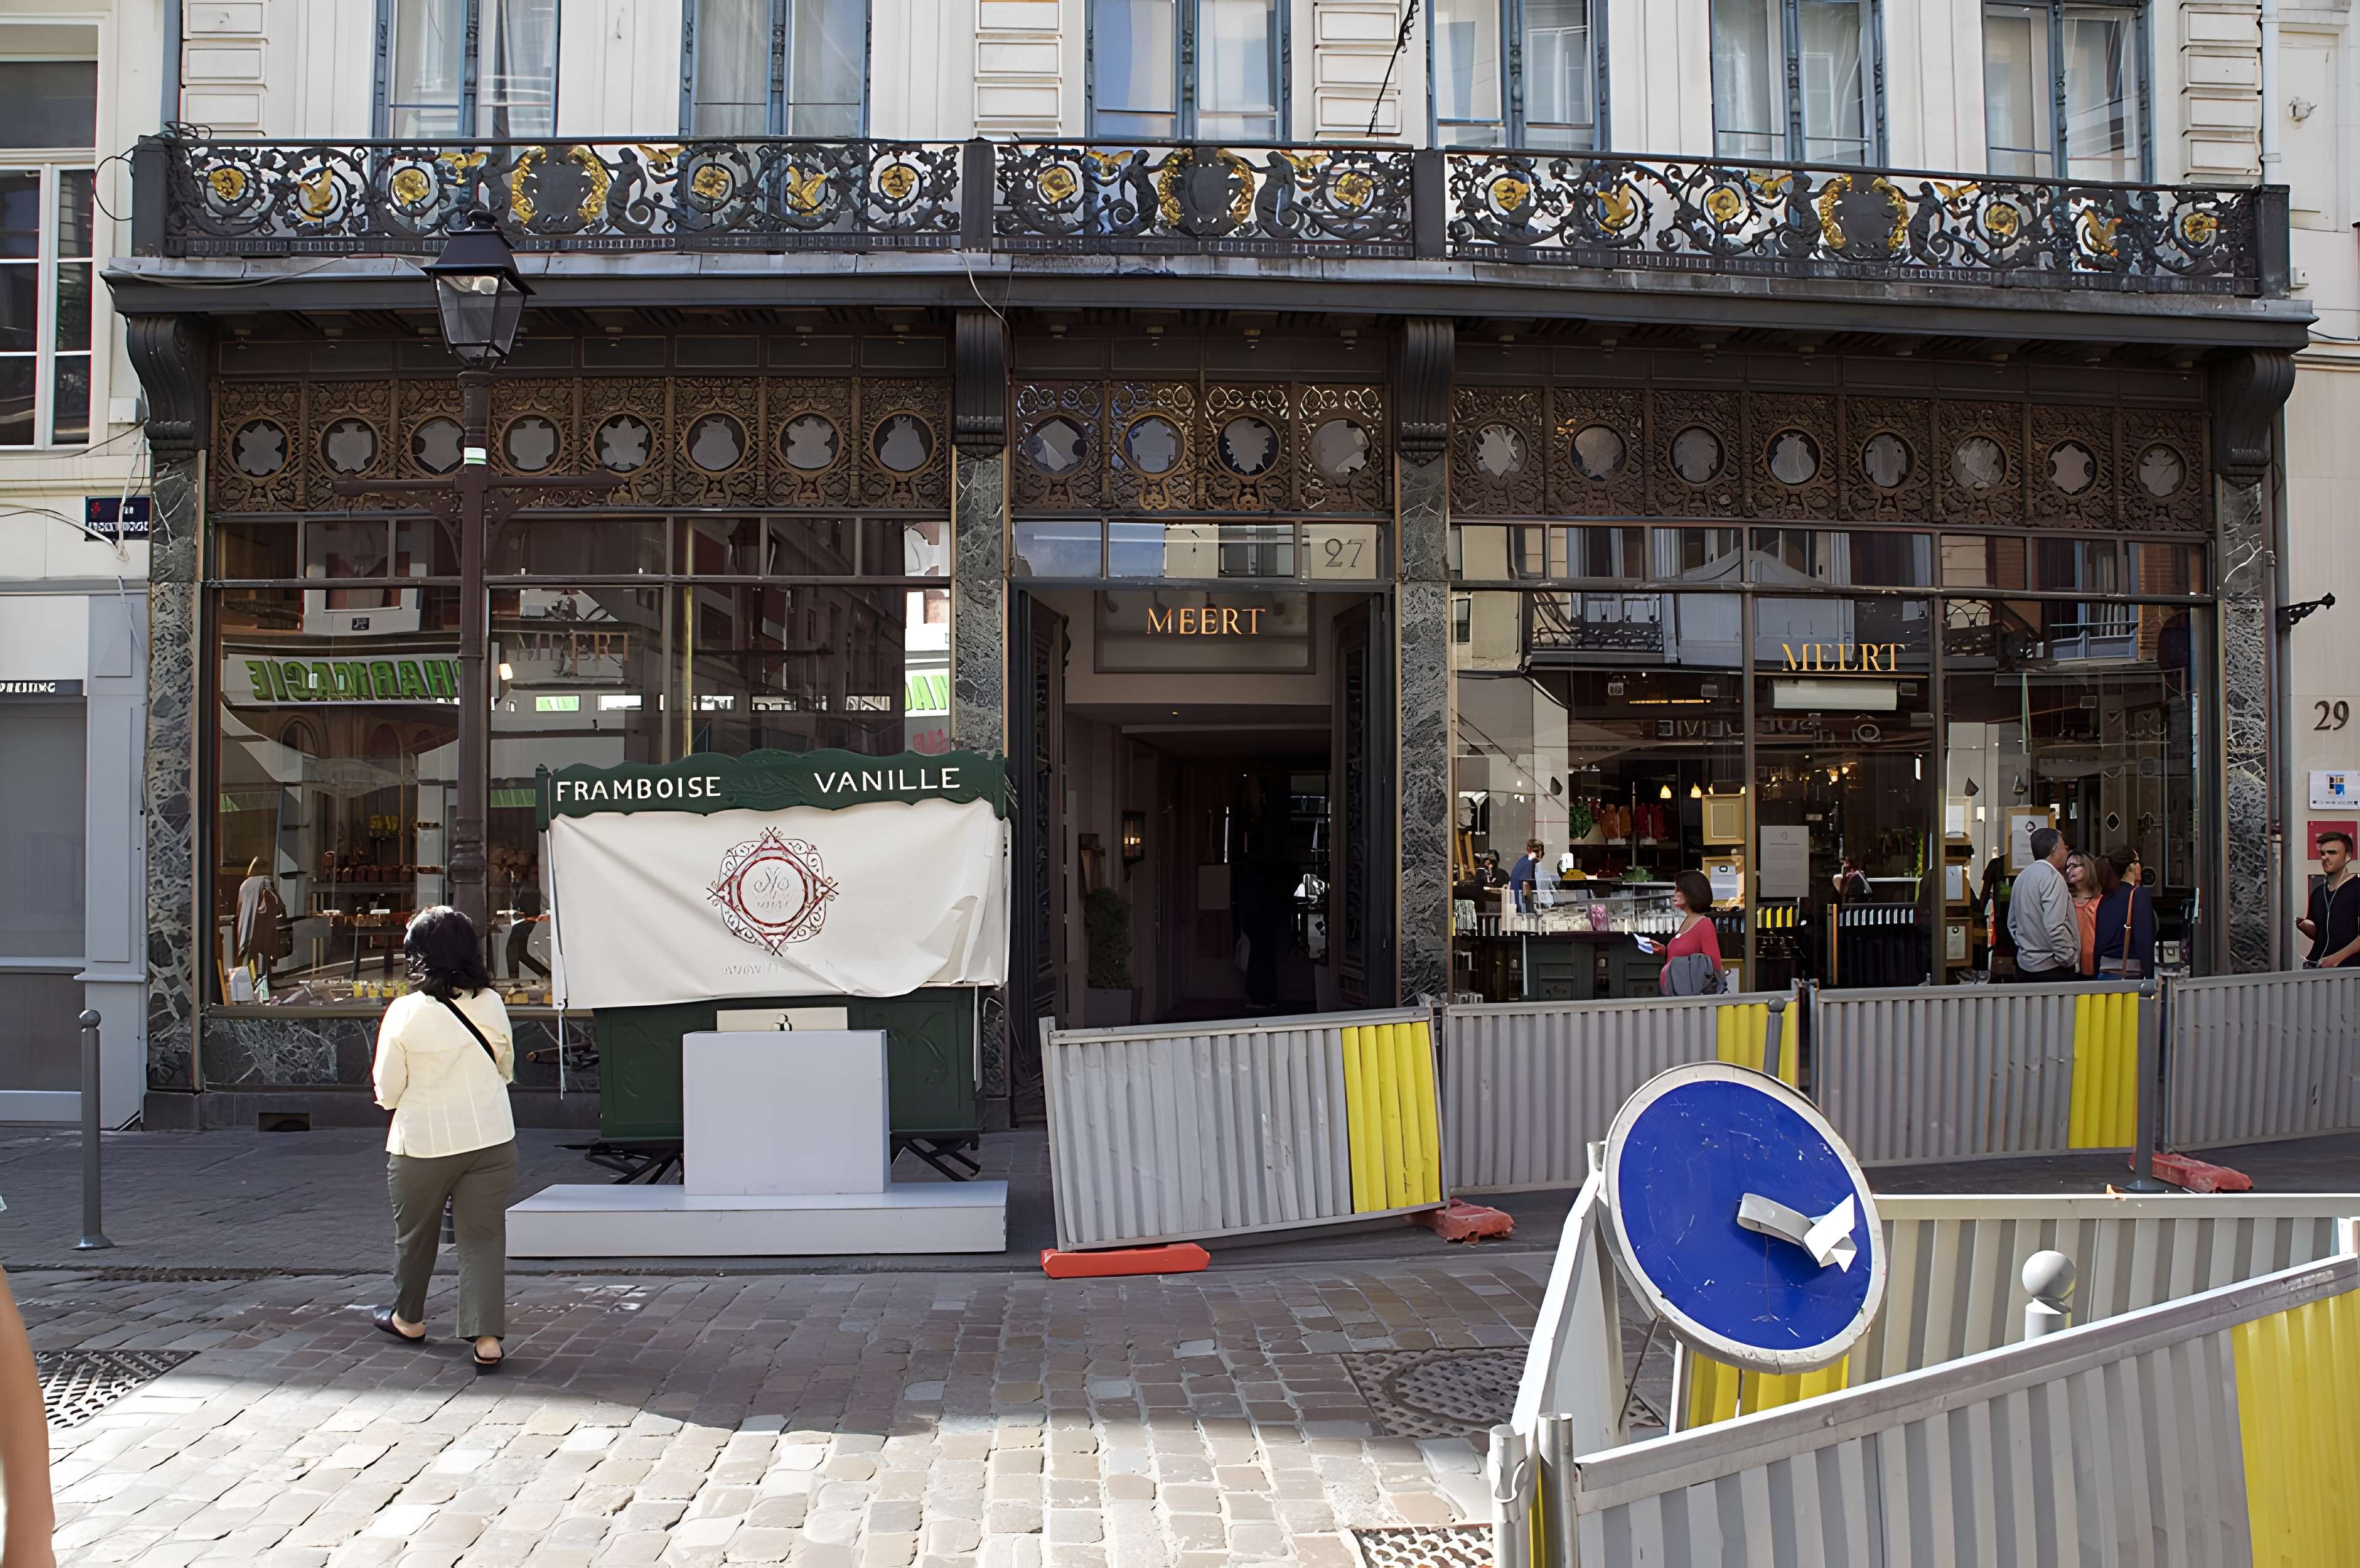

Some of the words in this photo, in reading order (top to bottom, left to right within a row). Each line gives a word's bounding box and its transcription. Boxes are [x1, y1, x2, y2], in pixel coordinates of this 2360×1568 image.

[1324, 538, 1367, 568] 27
[1146, 608, 1266, 635] MEERT
[1782, 643, 1907, 672] MEERT
[2313, 700, 2350, 731] 29
[556, 776, 722, 801] FRAMBOISE
[814, 767, 961, 794] VANILLE
